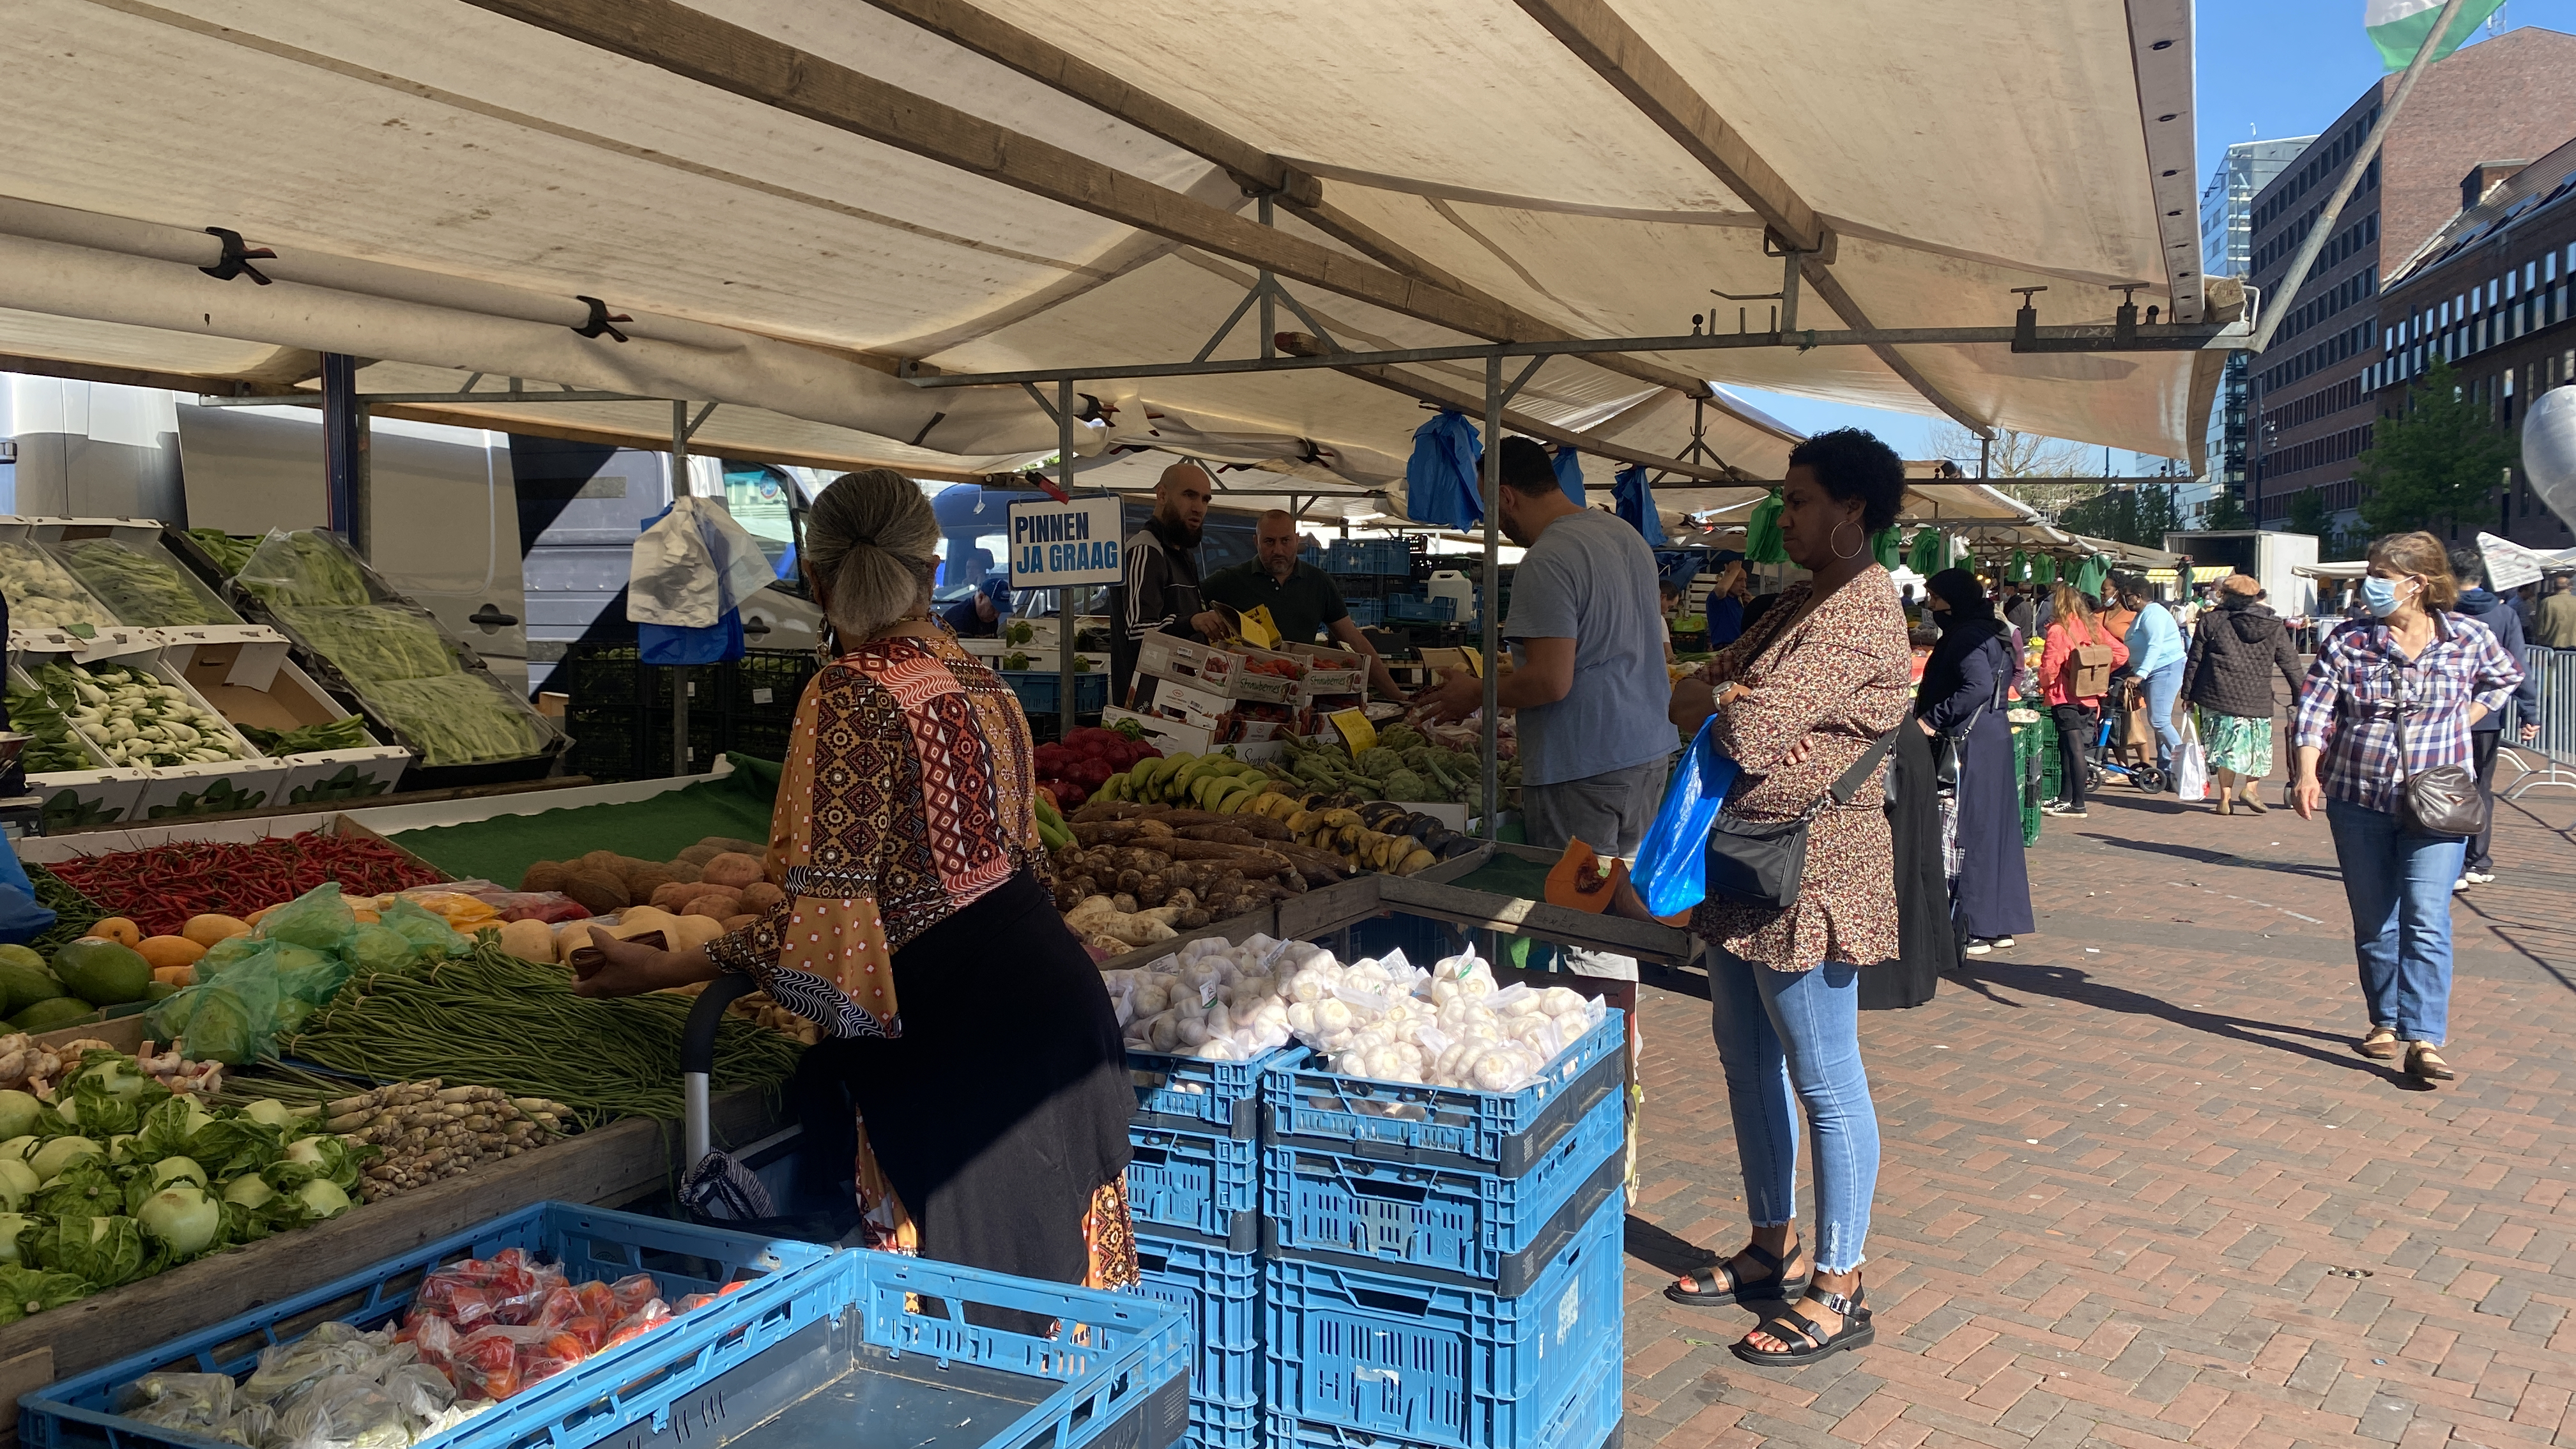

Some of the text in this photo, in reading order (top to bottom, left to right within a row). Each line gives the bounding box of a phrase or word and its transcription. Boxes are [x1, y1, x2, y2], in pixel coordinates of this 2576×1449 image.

[1015, 512, 1089, 544] PINNEN
[1016, 540, 1118, 574] JA GRAAG
[1239, 678, 1280, 694] Strawberries
[1310, 675, 1346, 686] Strawberries
[1177, 1197, 1192, 1215] 18
[1436, 1235, 1454, 1257] 18
